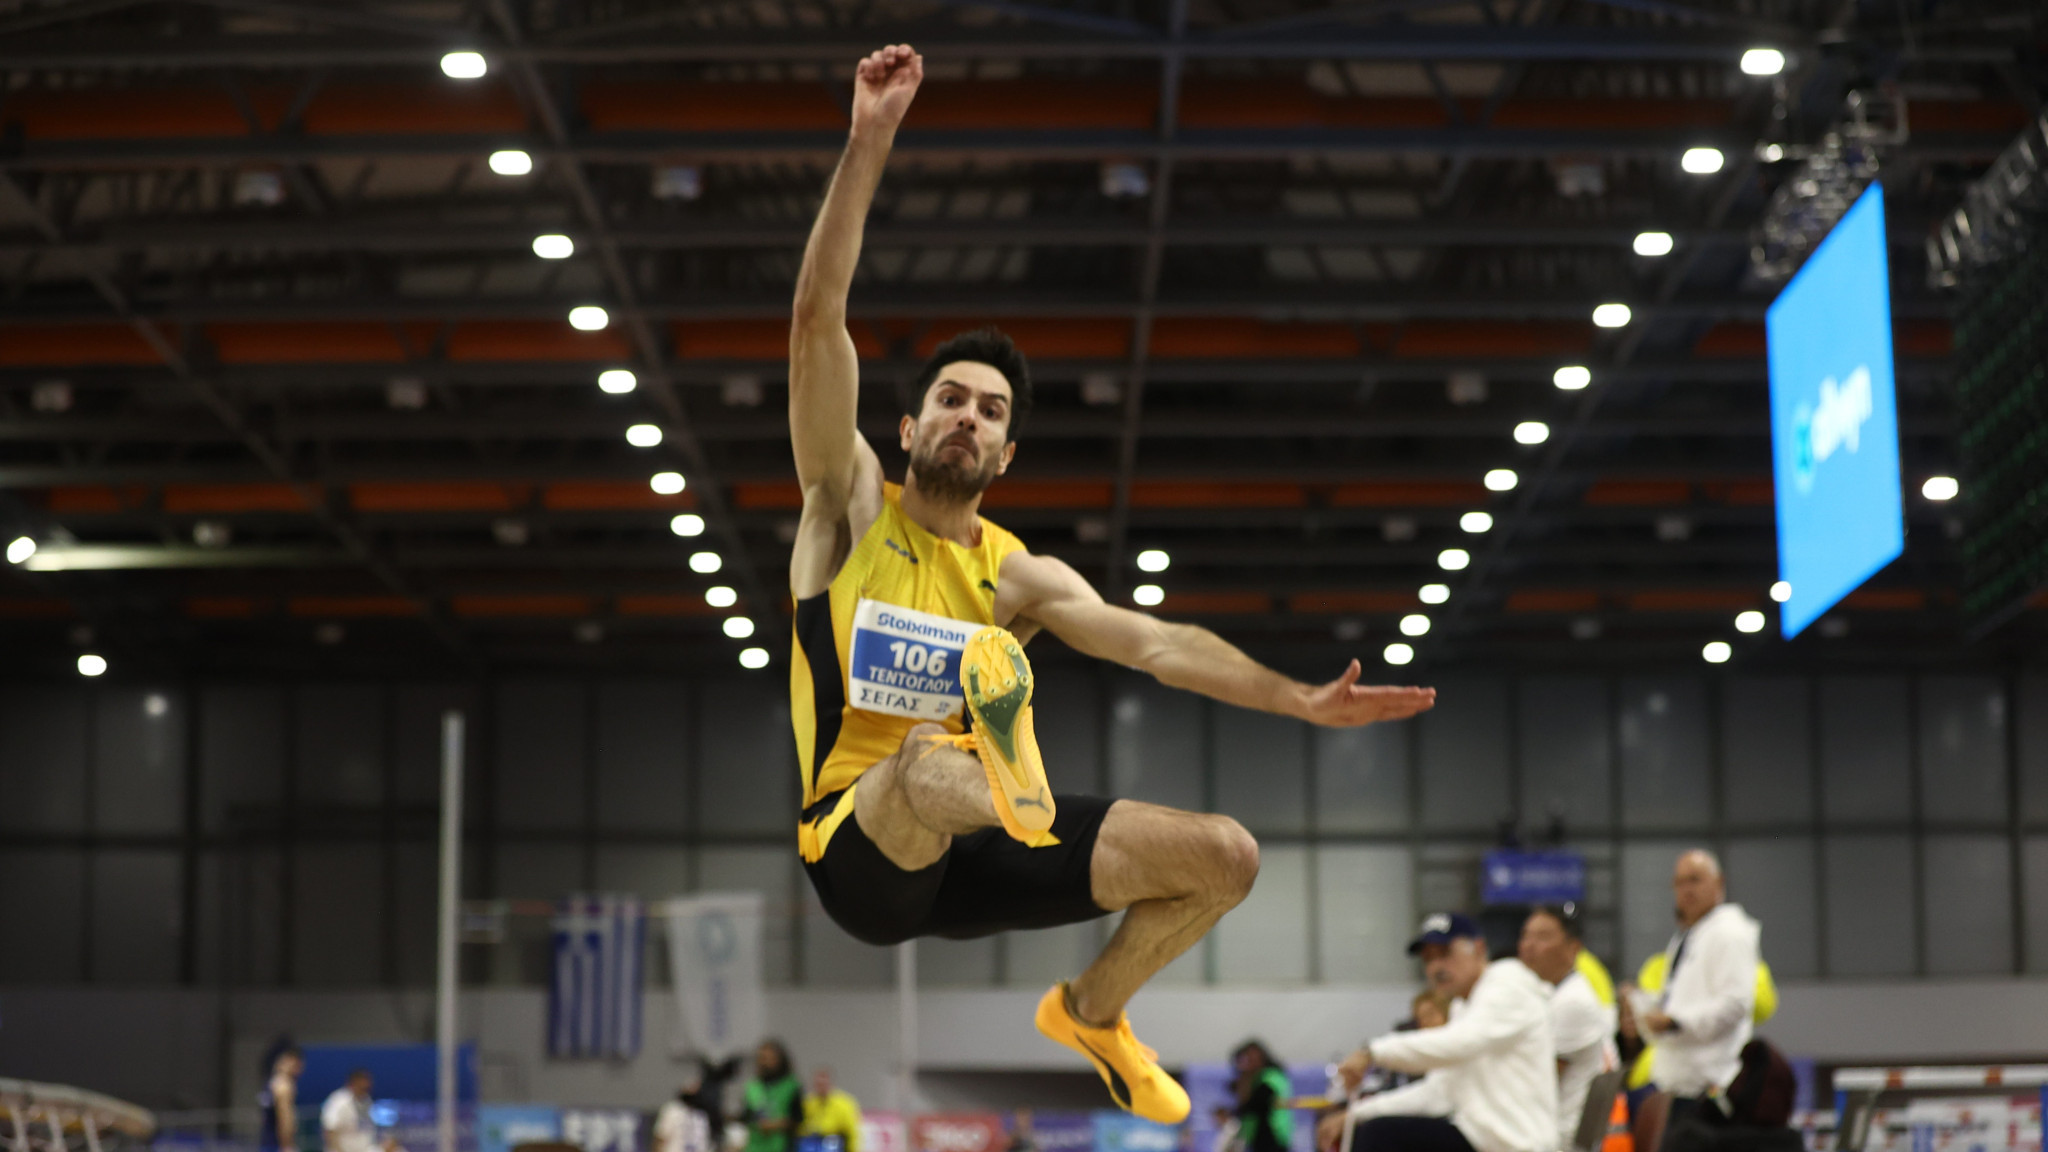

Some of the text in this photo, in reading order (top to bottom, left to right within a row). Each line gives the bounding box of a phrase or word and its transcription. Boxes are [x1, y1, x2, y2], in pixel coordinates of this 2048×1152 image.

[877, 612, 966, 643] Stoiximan
[889, 641, 949, 677] 106
[868, 666, 954, 694] ΤΕΝΤΟΓΛΟΥ
[859, 687, 922, 712] ΣΕΓΑΣ
